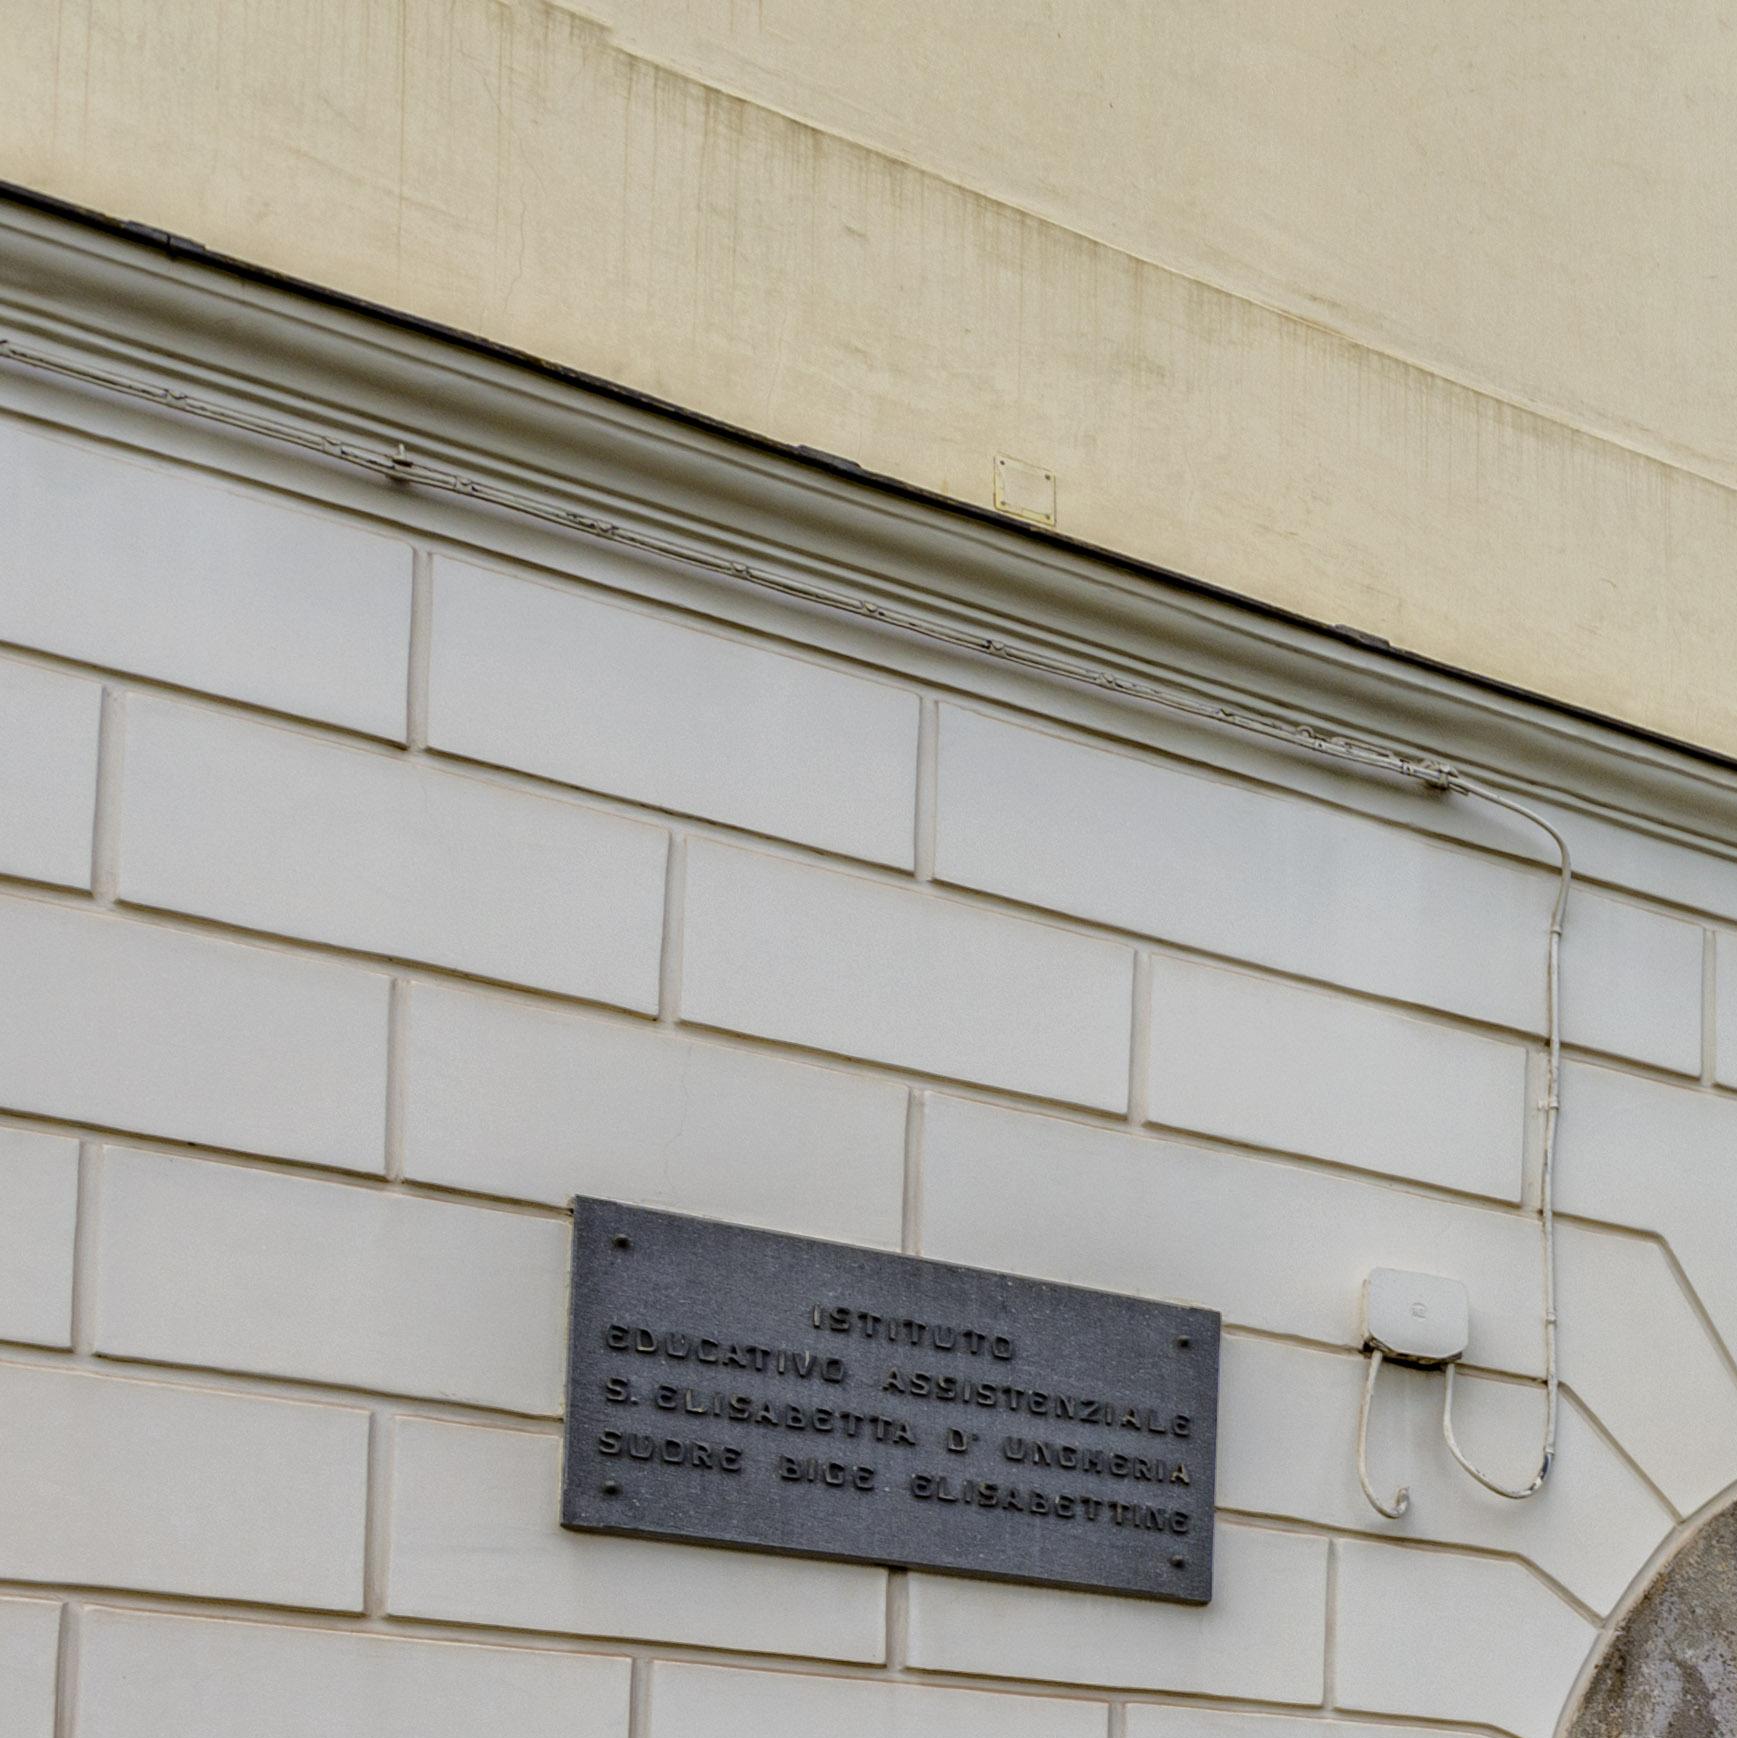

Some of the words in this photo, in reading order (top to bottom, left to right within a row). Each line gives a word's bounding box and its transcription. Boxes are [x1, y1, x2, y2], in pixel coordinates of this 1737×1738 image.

[606, 1323, 845, 1384] EDUCATIVO
[881, 1366, 1192, 1438] ASSISTENZIALE
[811, 1302, 1013, 1360] ISTITUTO
[598, 1428, 743, 1473] SUORE
[778, 1454, 876, 1491] BIGE
[910, 1474, 1191, 1535] ELISABETTINE
[604, 1376, 639, 1404] S.
[655, 1383, 916, 1446] ELISABETTA
[1004, 1436, 1191, 1486] UNGHERIA
